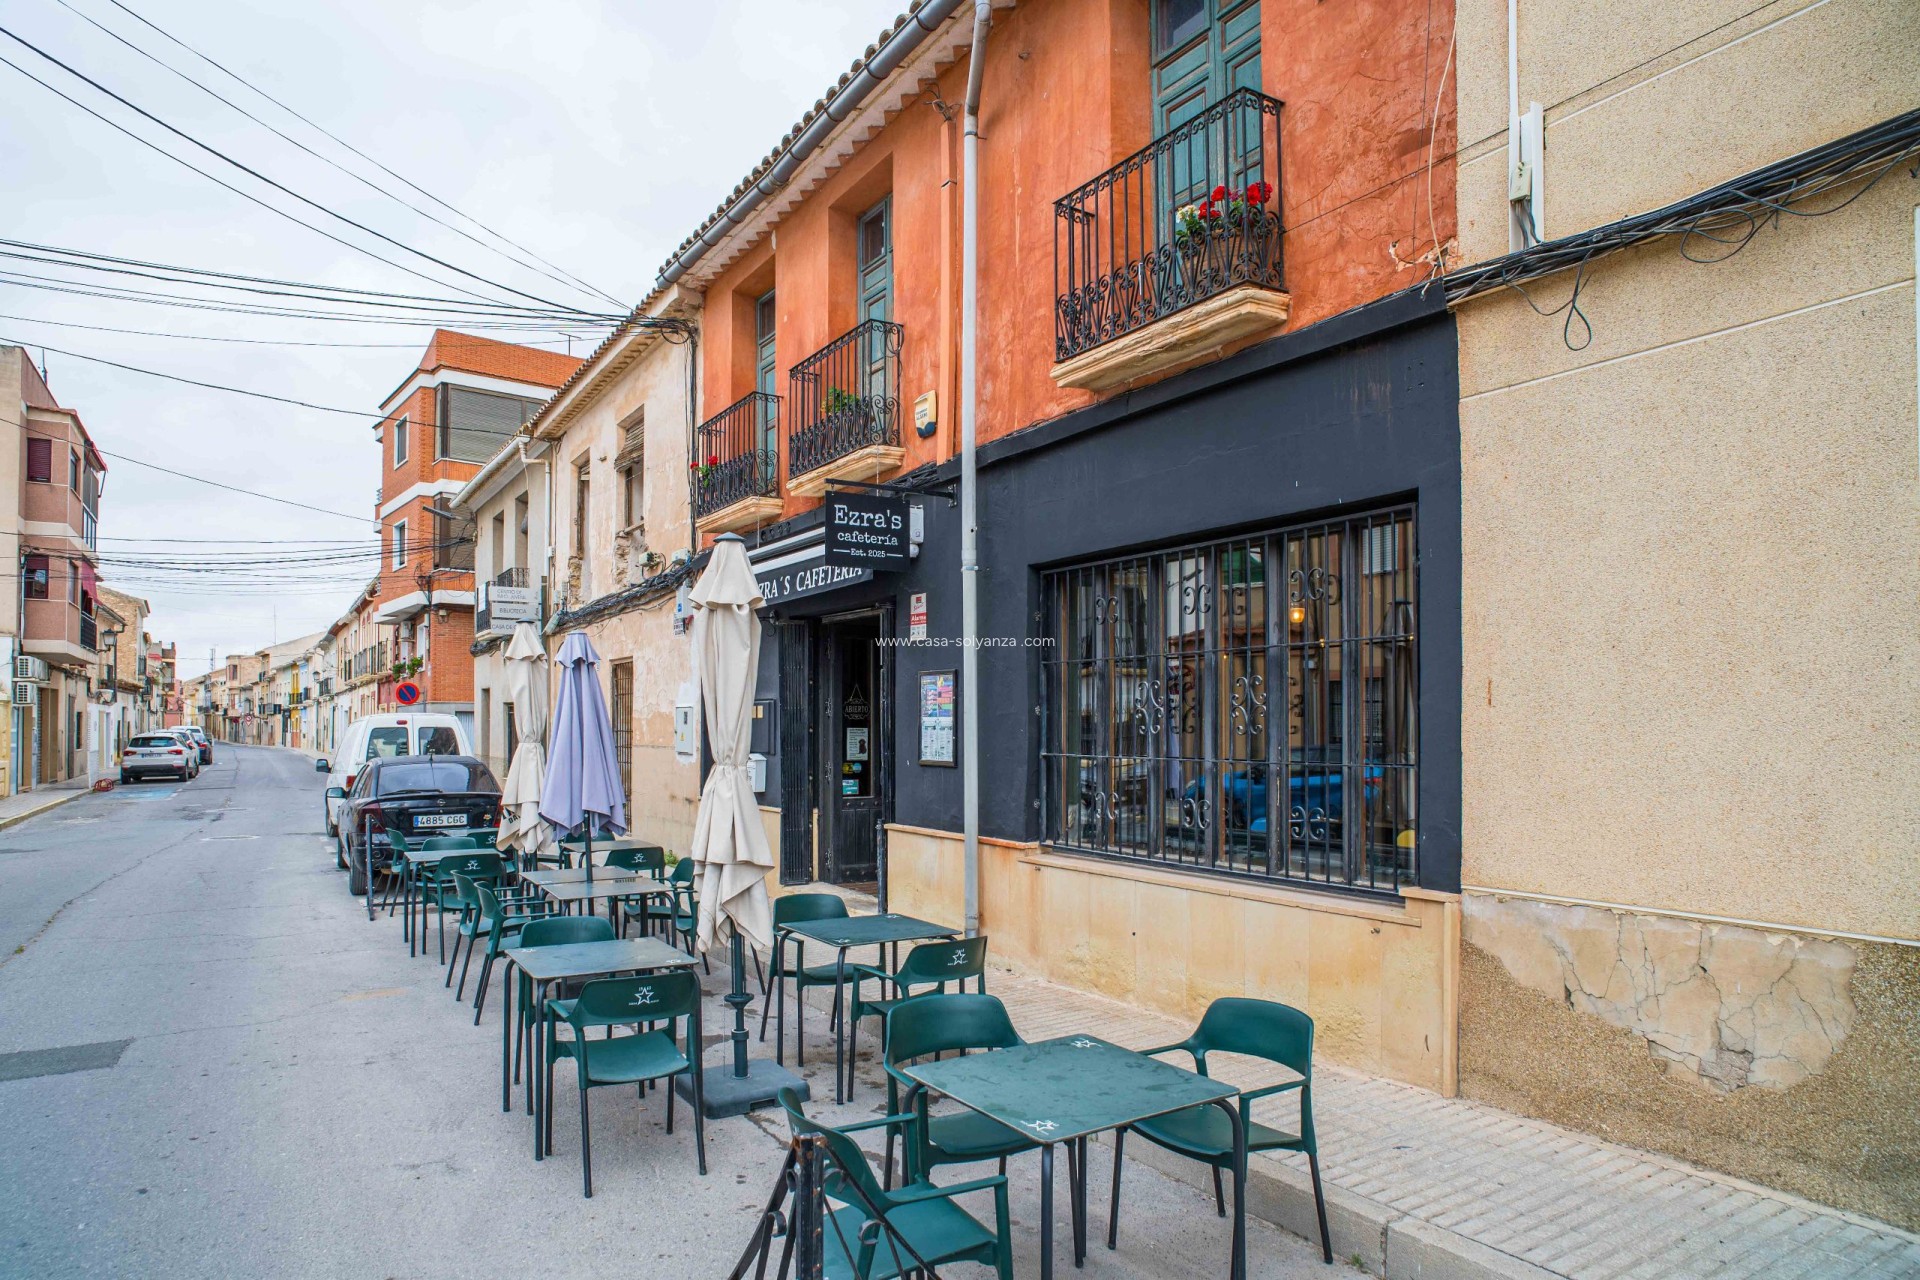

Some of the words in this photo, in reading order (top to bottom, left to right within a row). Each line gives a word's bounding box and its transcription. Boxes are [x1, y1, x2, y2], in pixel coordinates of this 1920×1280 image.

[834, 504, 902, 530] Ezra's
[837, 530, 898, 546] cafetería
[850, 547, 867, 557] Est.
[868, 549, 886, 558] 2025
[844, 705, 869, 713] ABIERTO
[420, 816, 443, 825] 4885
